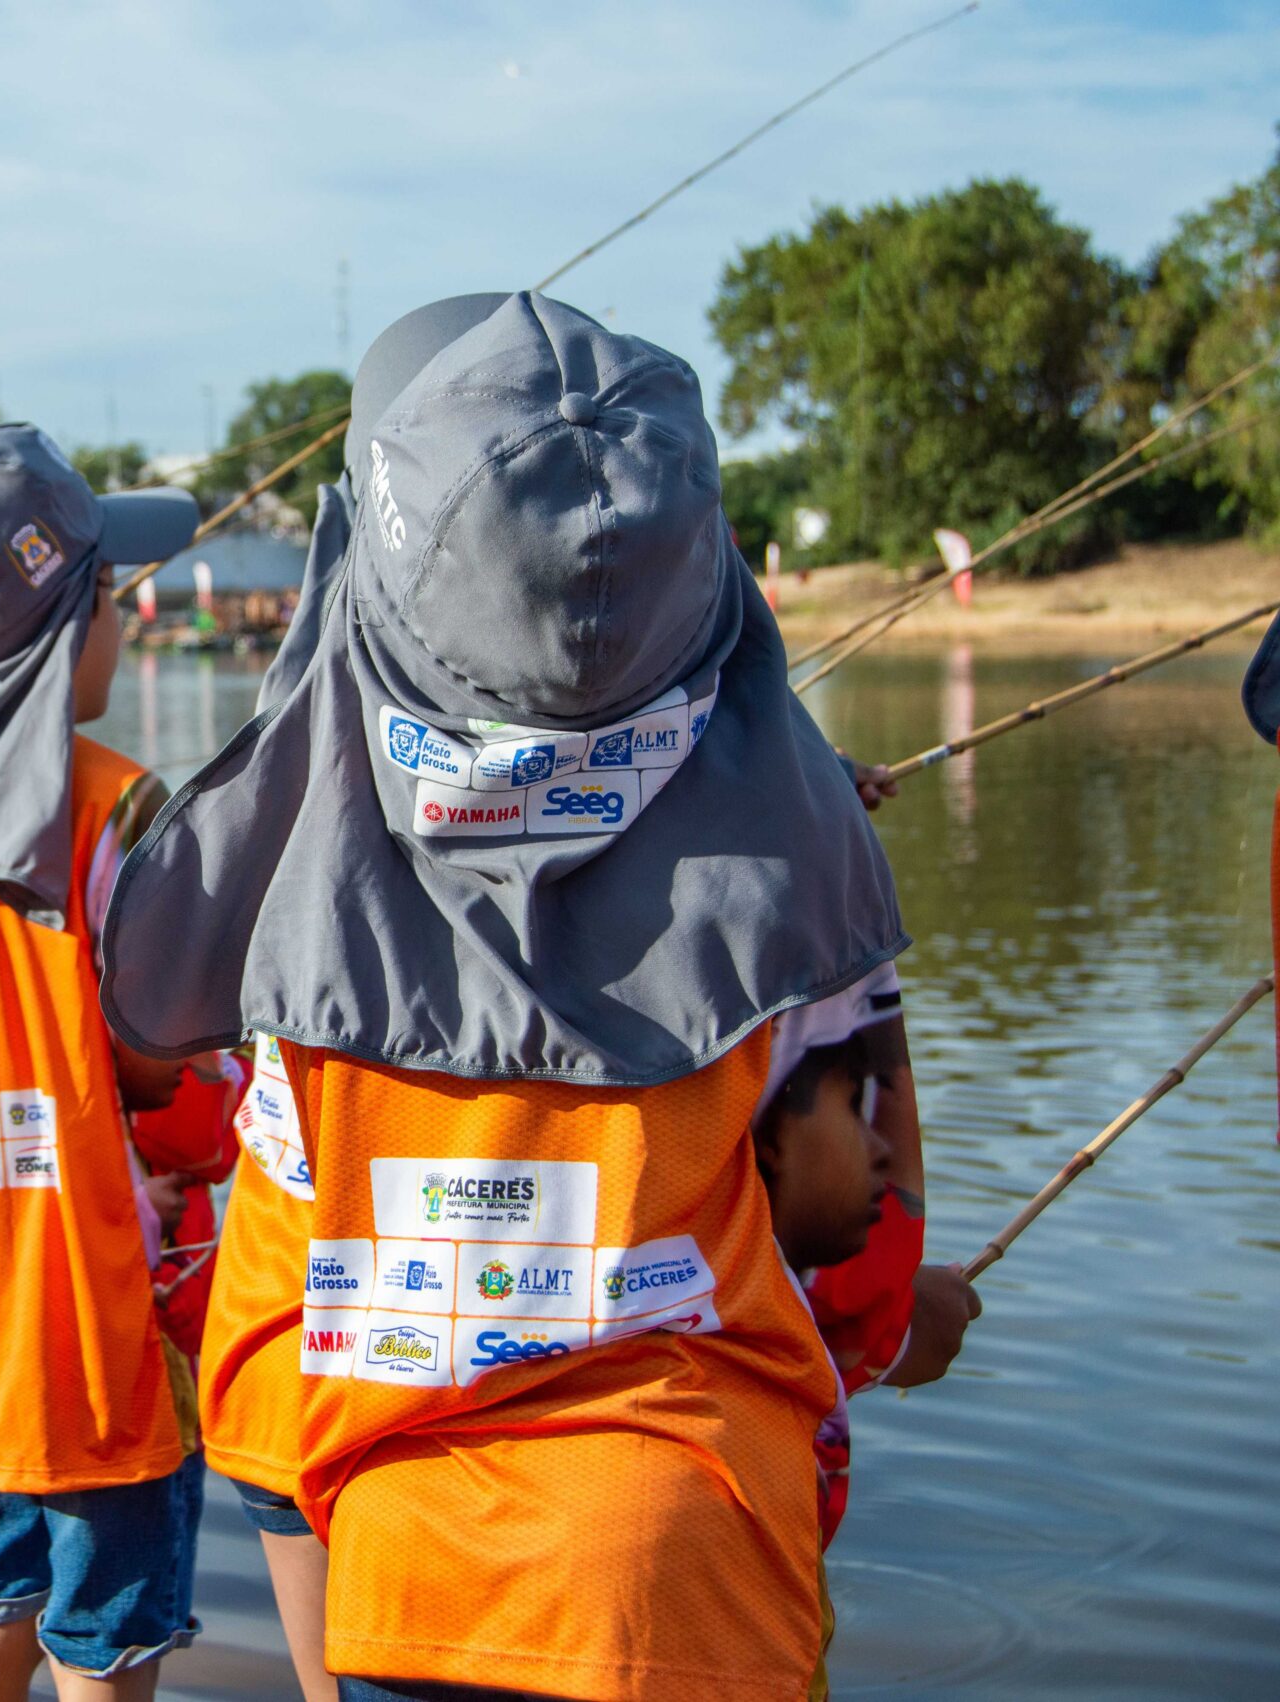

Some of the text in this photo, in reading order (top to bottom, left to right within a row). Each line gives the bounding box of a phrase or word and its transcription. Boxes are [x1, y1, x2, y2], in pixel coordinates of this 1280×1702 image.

[634, 730, 679, 748] ALMT
[423, 741, 451, 759] Mato
[421, 753, 459, 774] Grosso
[447, 805, 520, 824] YAMAHA
[541, 786, 625, 824] Seeg
[447, 1176, 535, 1201] CÁCERES
[487, 1202, 530, 1210] MUNICIPAL
[312, 1262, 345, 1276] Mato
[313, 1276, 359, 1290] Grosso
[518, 1268, 573, 1290] ALMT
[627, 1266, 698, 1293] CÁCERES
